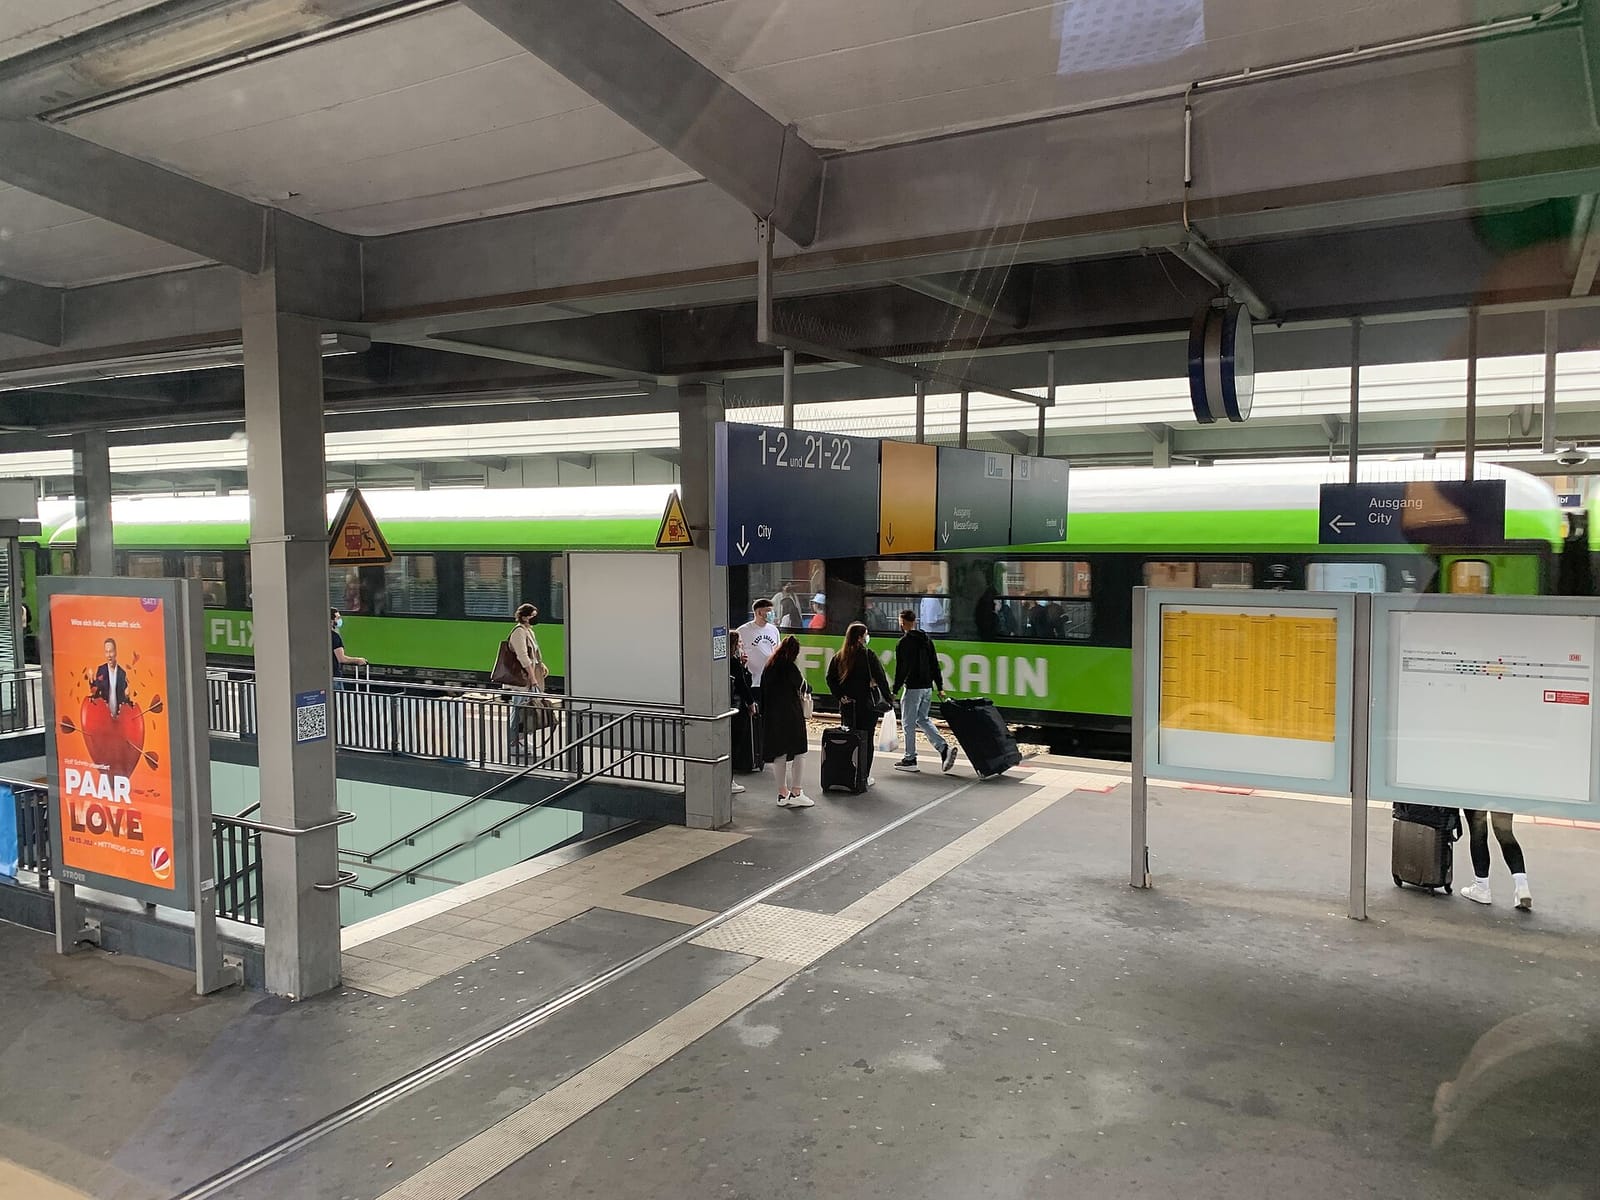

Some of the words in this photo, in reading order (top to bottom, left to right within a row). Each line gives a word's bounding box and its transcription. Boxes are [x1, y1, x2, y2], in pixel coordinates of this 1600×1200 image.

[758, 430, 788, 467] 1-2
[789, 456, 803, 468] und
[804, 435, 851, 471] 21-22
[1369, 497, 1423, 510] Ausgang
[757, 524, 772, 540] City
[1368, 512, 1392, 526] City
[65, 768, 132, 804] PAAR
[69, 802, 144, 841] LOVE
